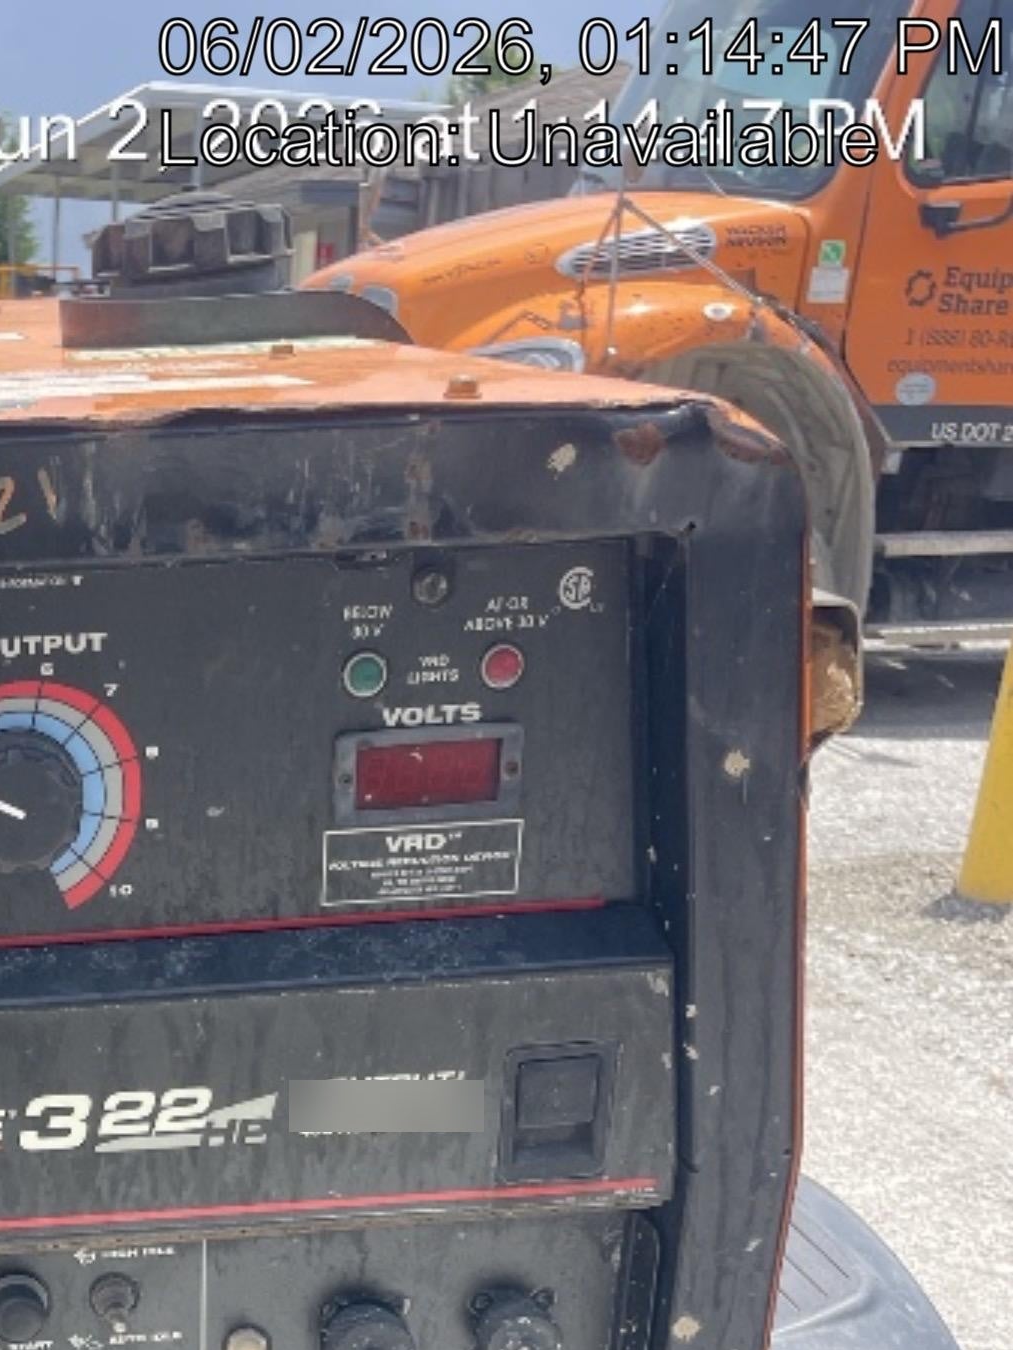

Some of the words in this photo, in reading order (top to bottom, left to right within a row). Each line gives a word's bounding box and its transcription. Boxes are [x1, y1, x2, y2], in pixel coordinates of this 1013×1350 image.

[939, 293, 1009, 316] Share
[931, 422, 958, 441] US
[960, 422, 1001, 441] DOT
[104, 683, 119, 698] 7
[382, 702, 484, 727] VOLTS
[109, 883, 134, 898] 10
[20, 1087, 214, 1152] 322
